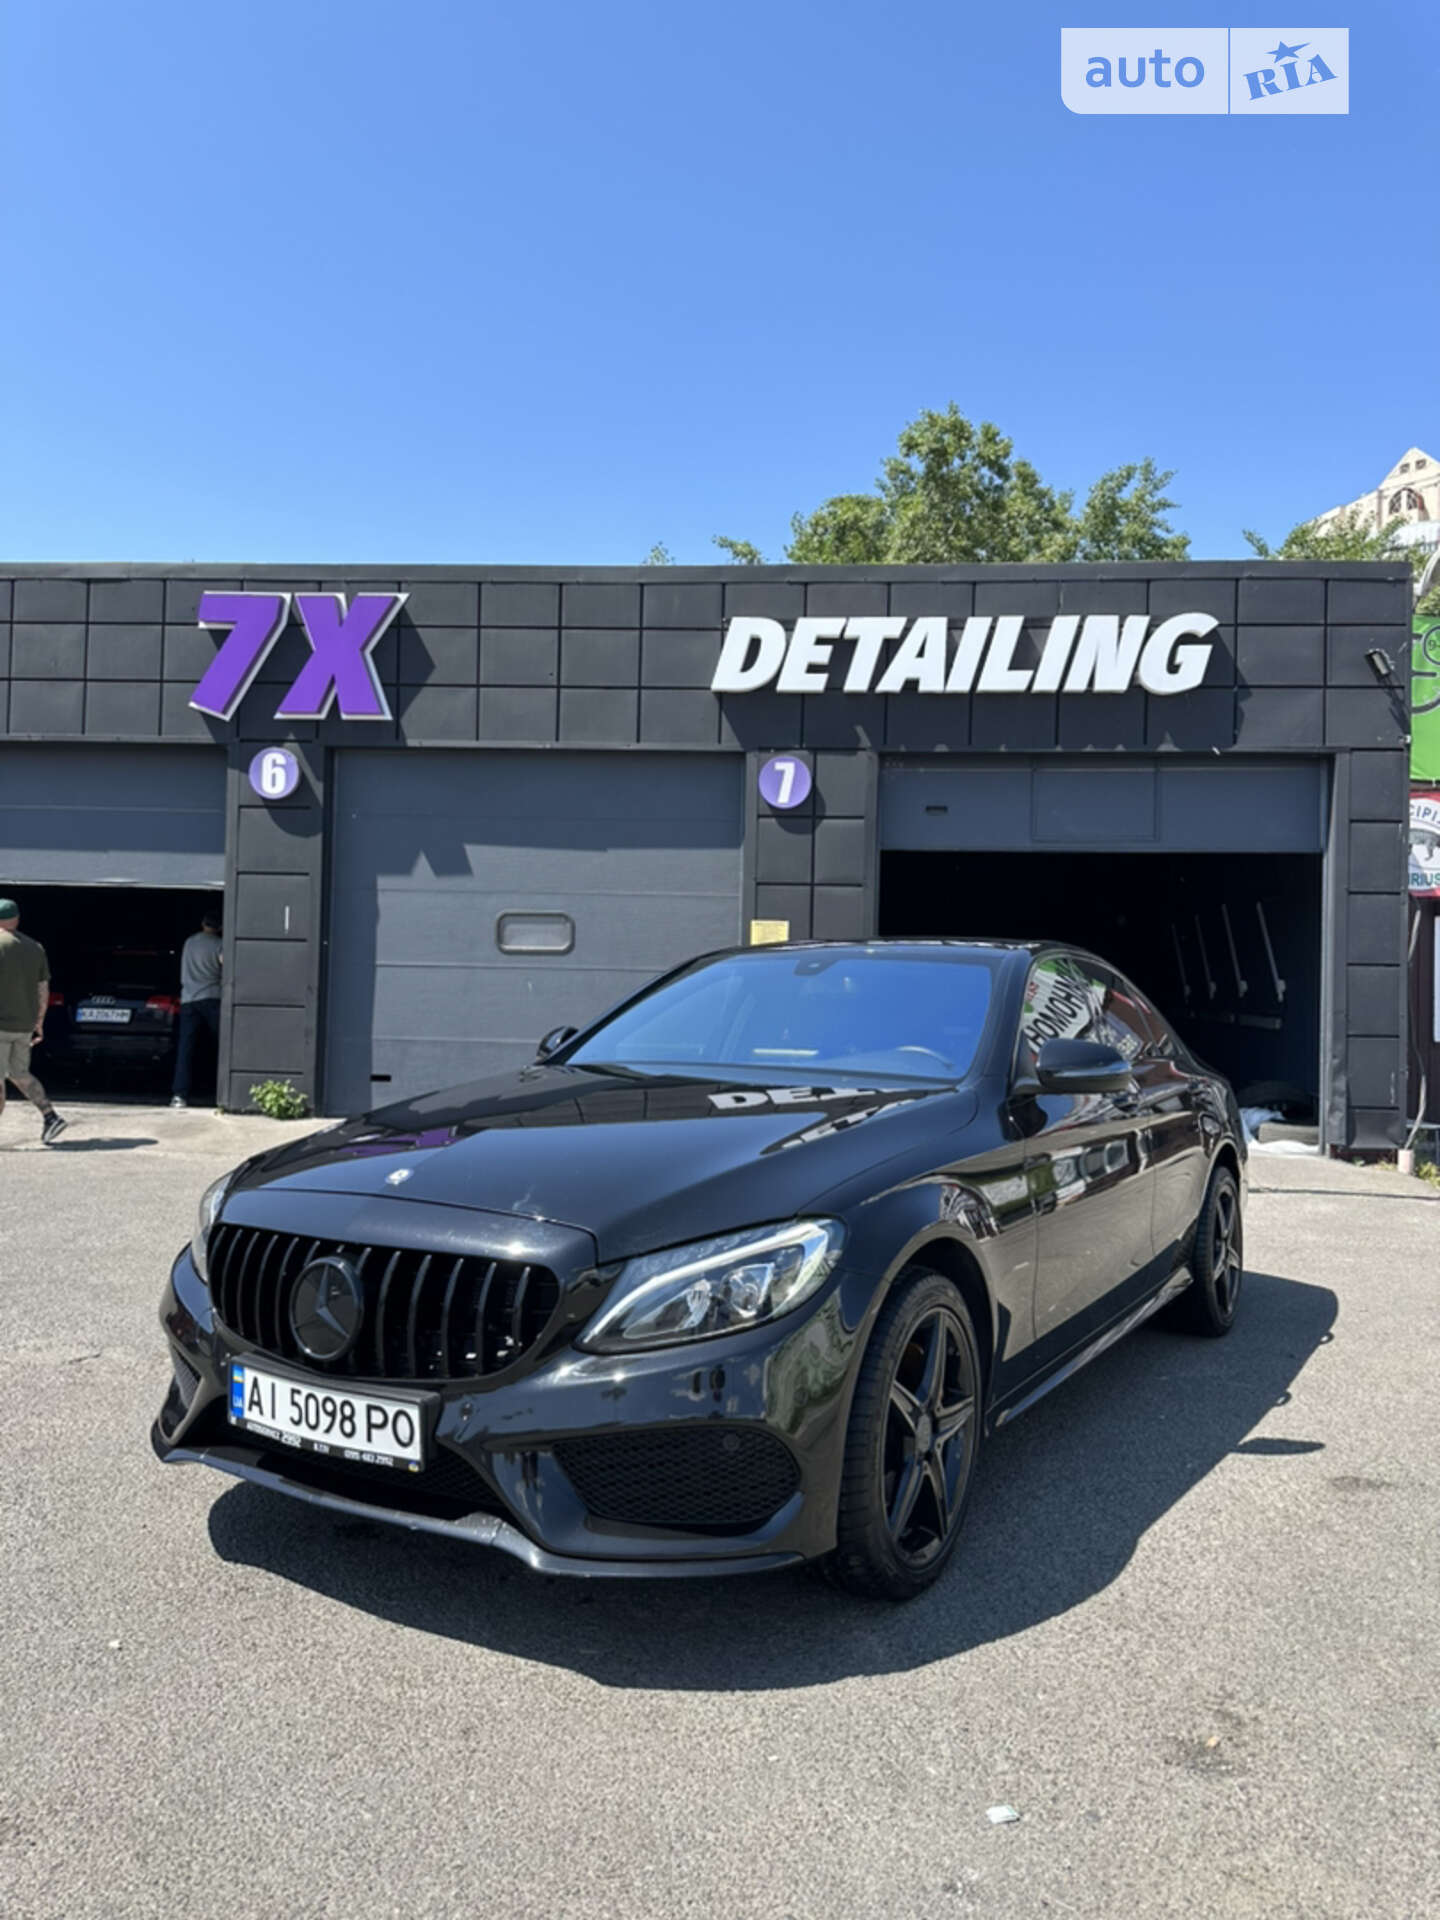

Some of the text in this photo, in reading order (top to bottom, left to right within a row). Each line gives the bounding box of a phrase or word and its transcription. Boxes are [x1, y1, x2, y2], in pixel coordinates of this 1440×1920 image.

[188, 590, 410, 721] 7X
[711, 612, 1219, 695] DETAILING
[262, 753, 286, 794] 6
[774, 762, 796, 803] 7
[248, 1376, 415, 1448] AI 5098 PO
